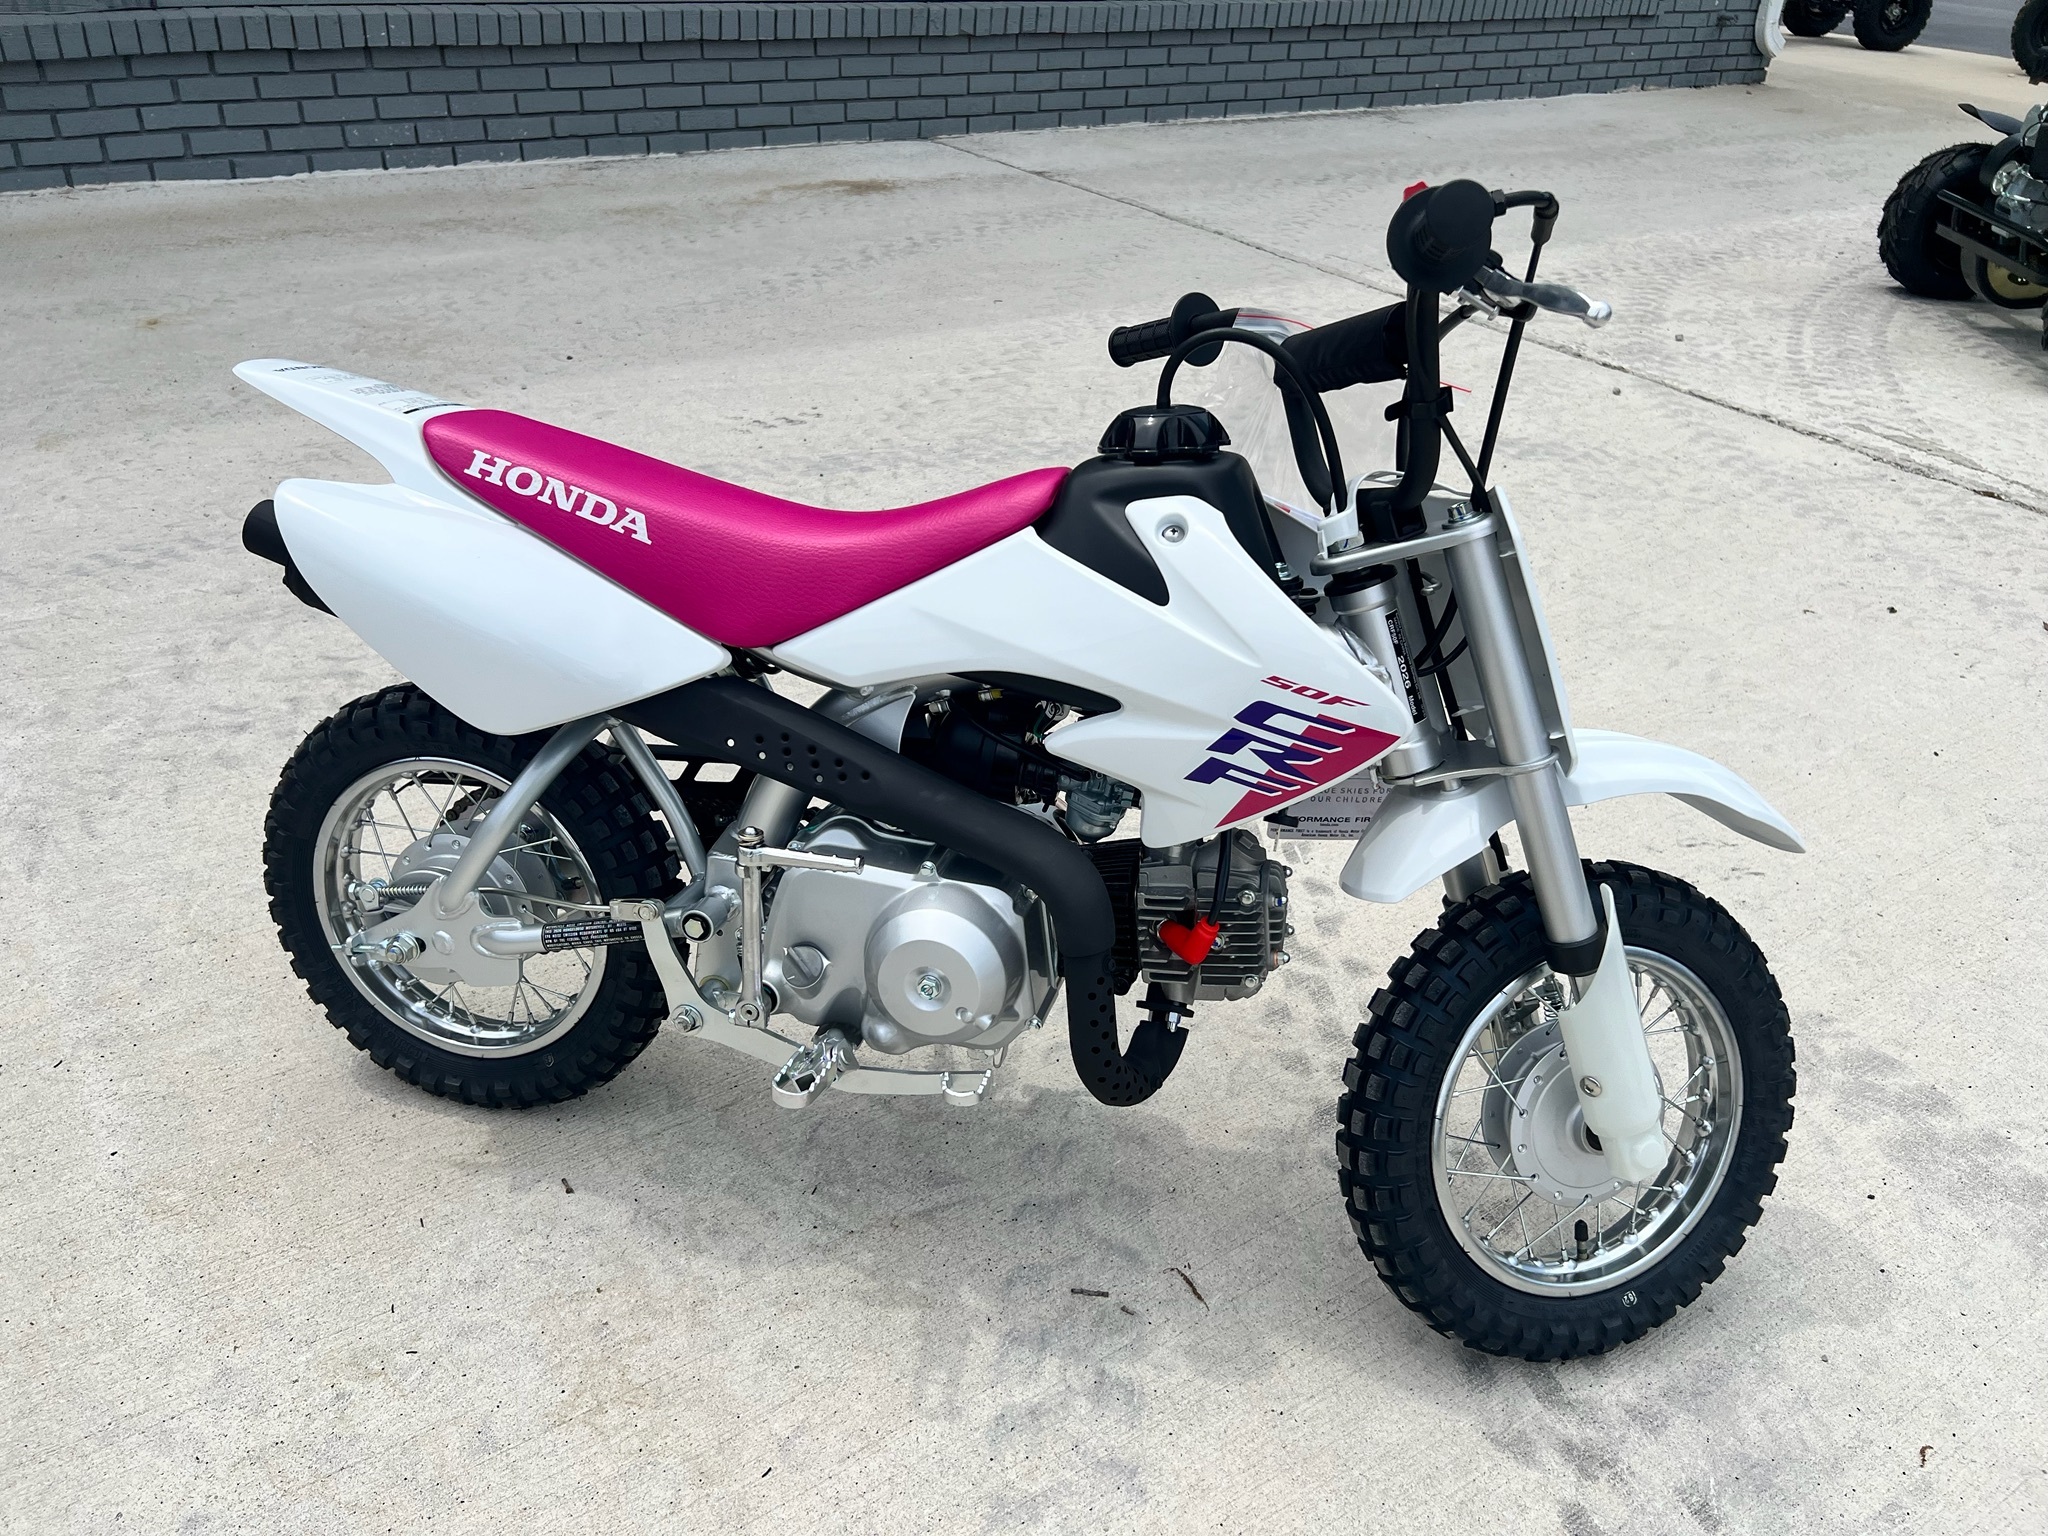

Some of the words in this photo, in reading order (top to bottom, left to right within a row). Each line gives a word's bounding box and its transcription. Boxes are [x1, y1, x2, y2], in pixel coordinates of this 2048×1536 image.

[463, 449, 652, 545] HONDA
[1260, 675, 1372, 707] 50F
[1397, 655, 1412, 689] 2026
[1408, 695, 1418, 716] Model
[1310, 795, 1331, 803] OUR
[1320, 787, 1336, 795] UE
[1340, 787, 1370, 795] SKIES
